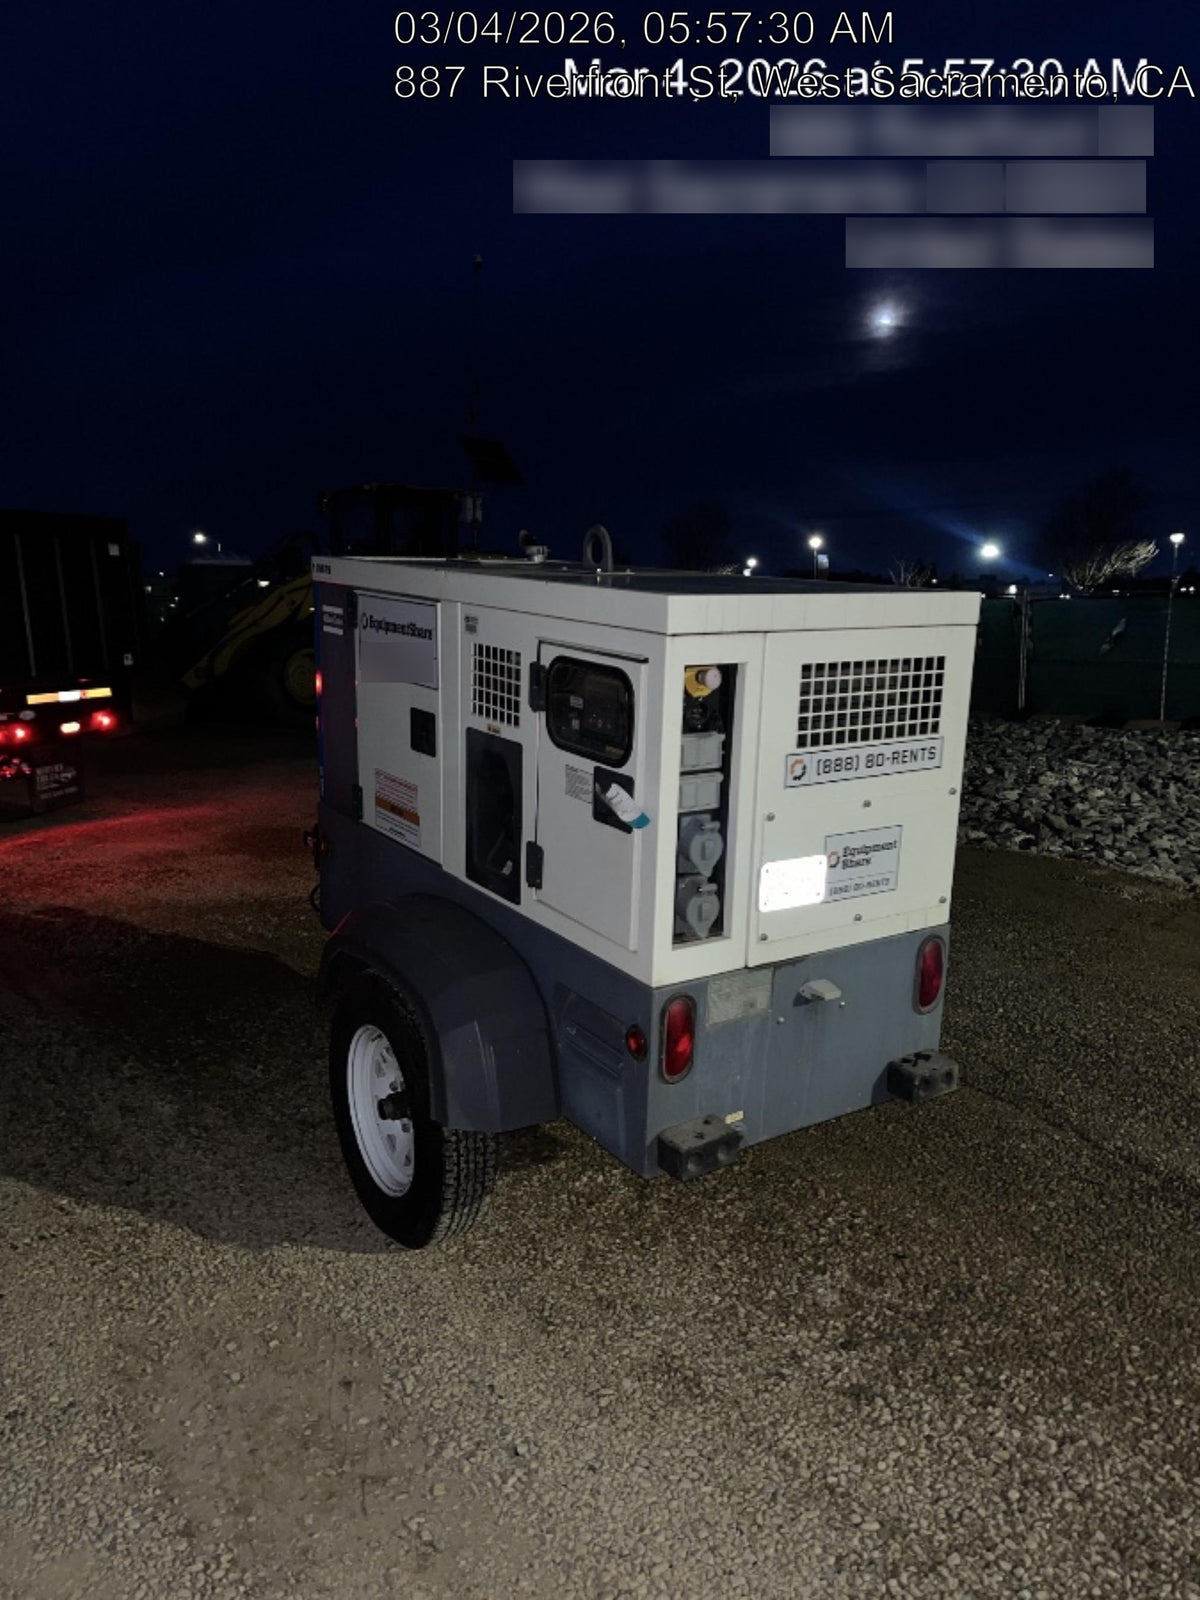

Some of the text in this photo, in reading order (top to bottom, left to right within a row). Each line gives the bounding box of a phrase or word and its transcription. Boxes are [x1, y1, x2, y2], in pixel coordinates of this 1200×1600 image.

[816, 746, 937, 776] (888) 80-RENTS
[842, 840, 898, 858] Equipment
